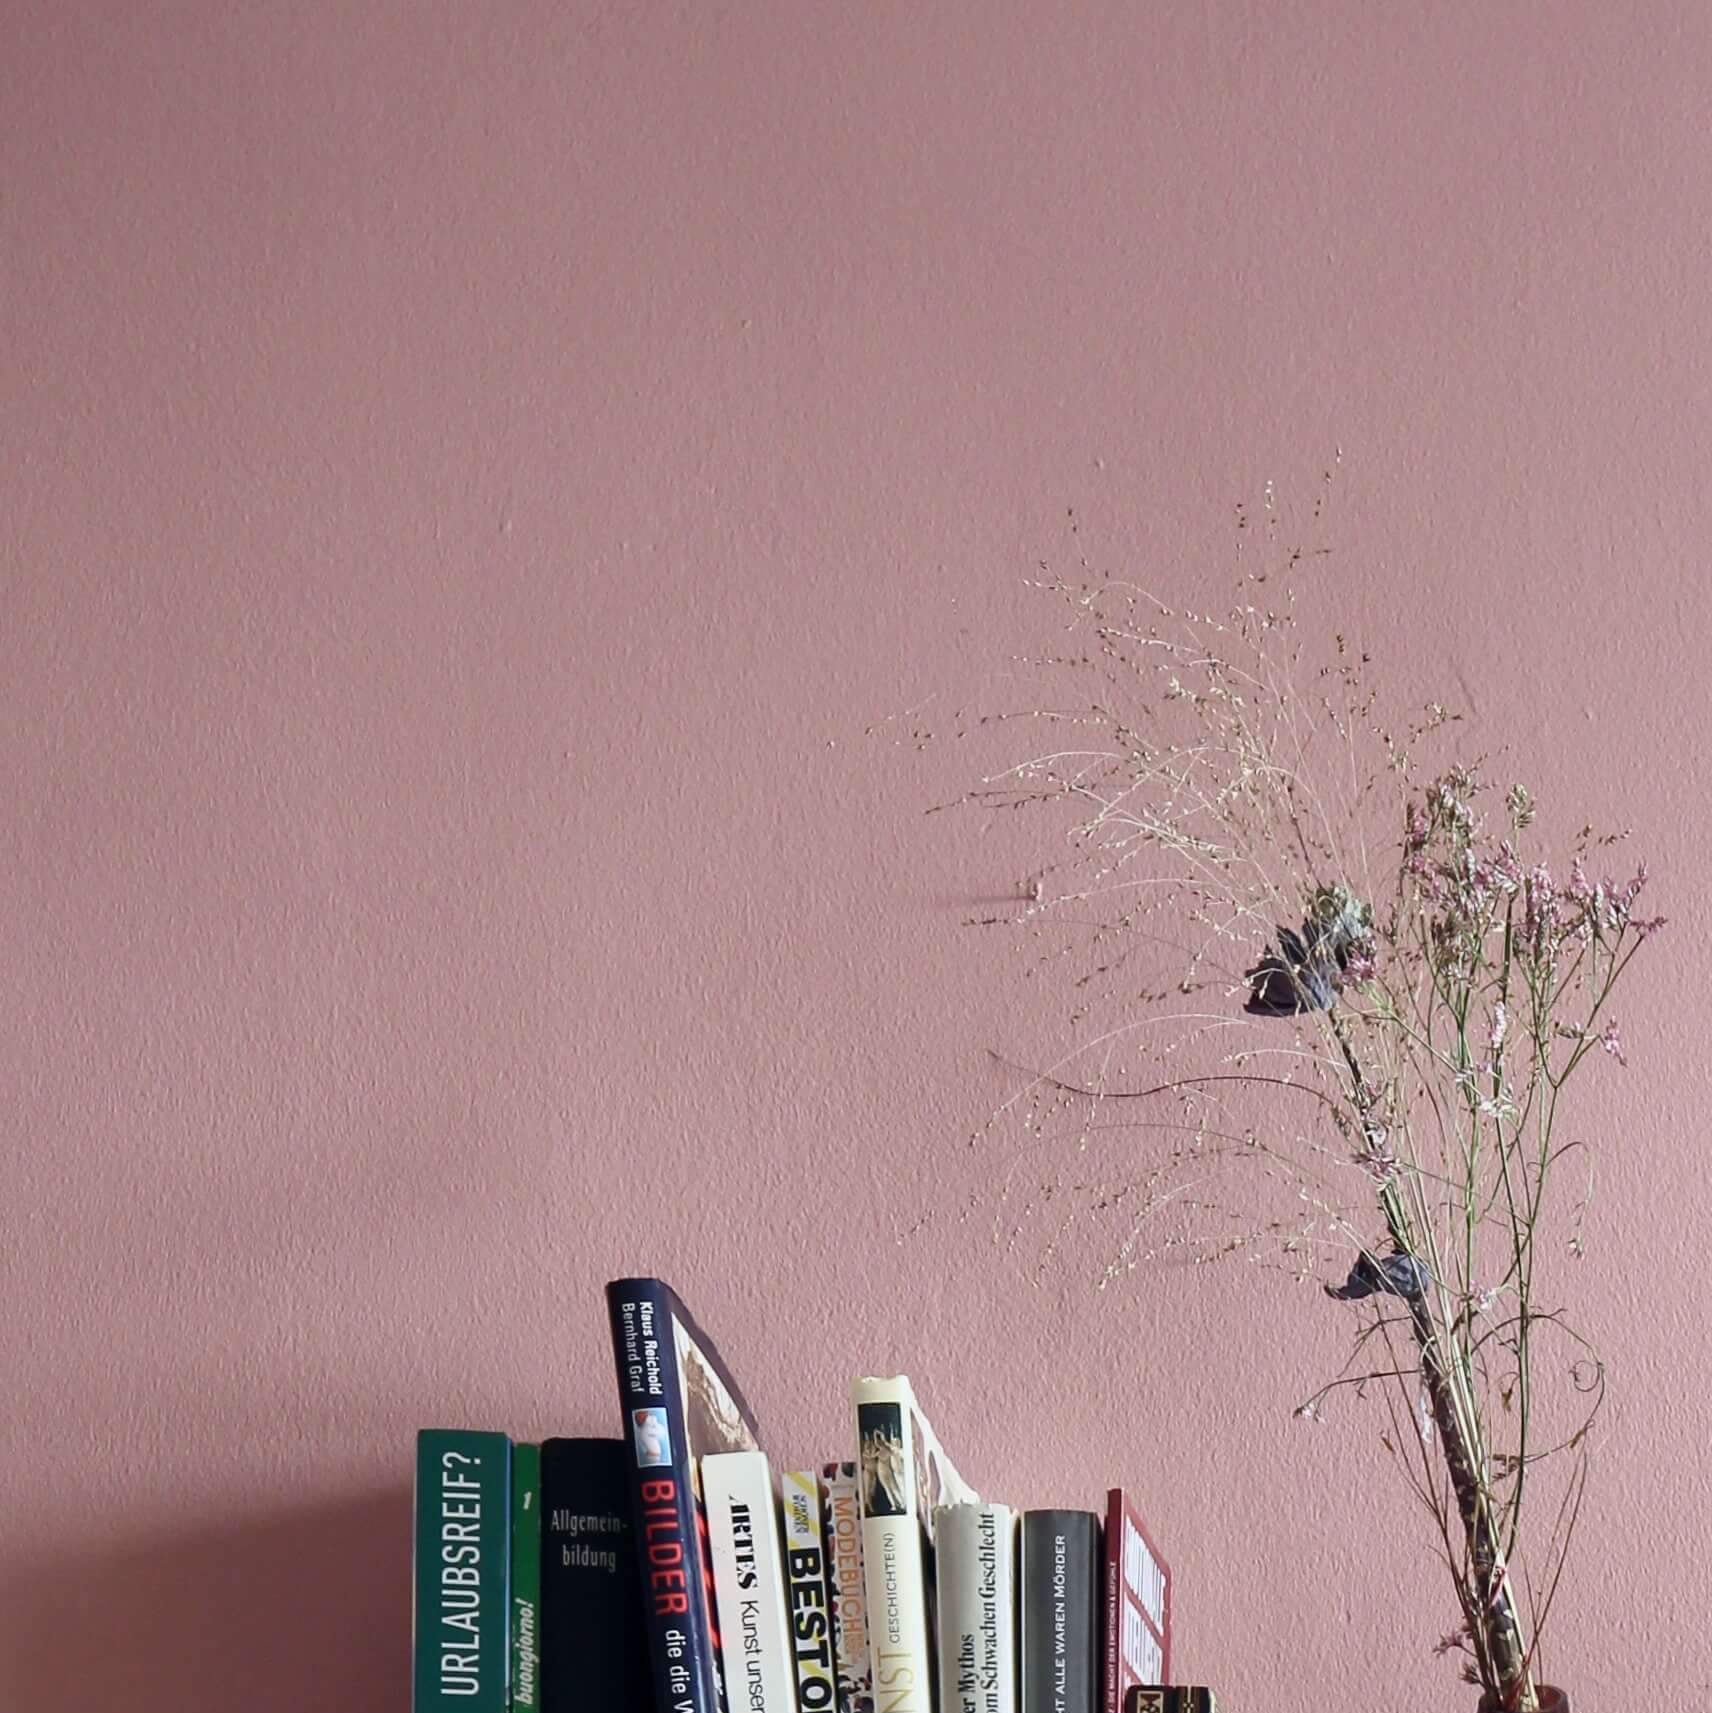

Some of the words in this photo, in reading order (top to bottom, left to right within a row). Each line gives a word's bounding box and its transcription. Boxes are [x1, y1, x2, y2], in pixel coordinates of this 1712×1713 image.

[622, 1303, 640, 1361] Bernhard
[640, 1302, 654, 1336] Klaus
[629, 1365, 645, 1393] Graf
[643, 1340, 663, 1395] Reichold
[550, 1510, 629, 1534] Allgemein-
[641, 1480, 688, 1616] BILDER
[441, 1451, 482, 1695] URLAUBSREIF?
[562, 1544, 618, 1573] bildung
[834, 1497, 864, 1633] MODEBUCH
[977, 1513, 997, 1600] Geschlecht
[1053, 1535, 1066, 1598] MÖRDER
[789, 1547, 831, 1669] BEST
[882, 1533, 901, 1644] GESCHICHTE(N)
[514, 1599, 540, 1704] buongiorno!
[665, 1630, 687, 1658] die
[739, 1601, 762, 1656] Kunst
[979, 1601, 999, 1690] Schwachen
[1054, 1602, 1066, 1653] WAREN
[669, 1666, 690, 1694] die
[958, 1634, 980, 1693] Mythos
[1054, 1657, 1066, 1695] ALLE
